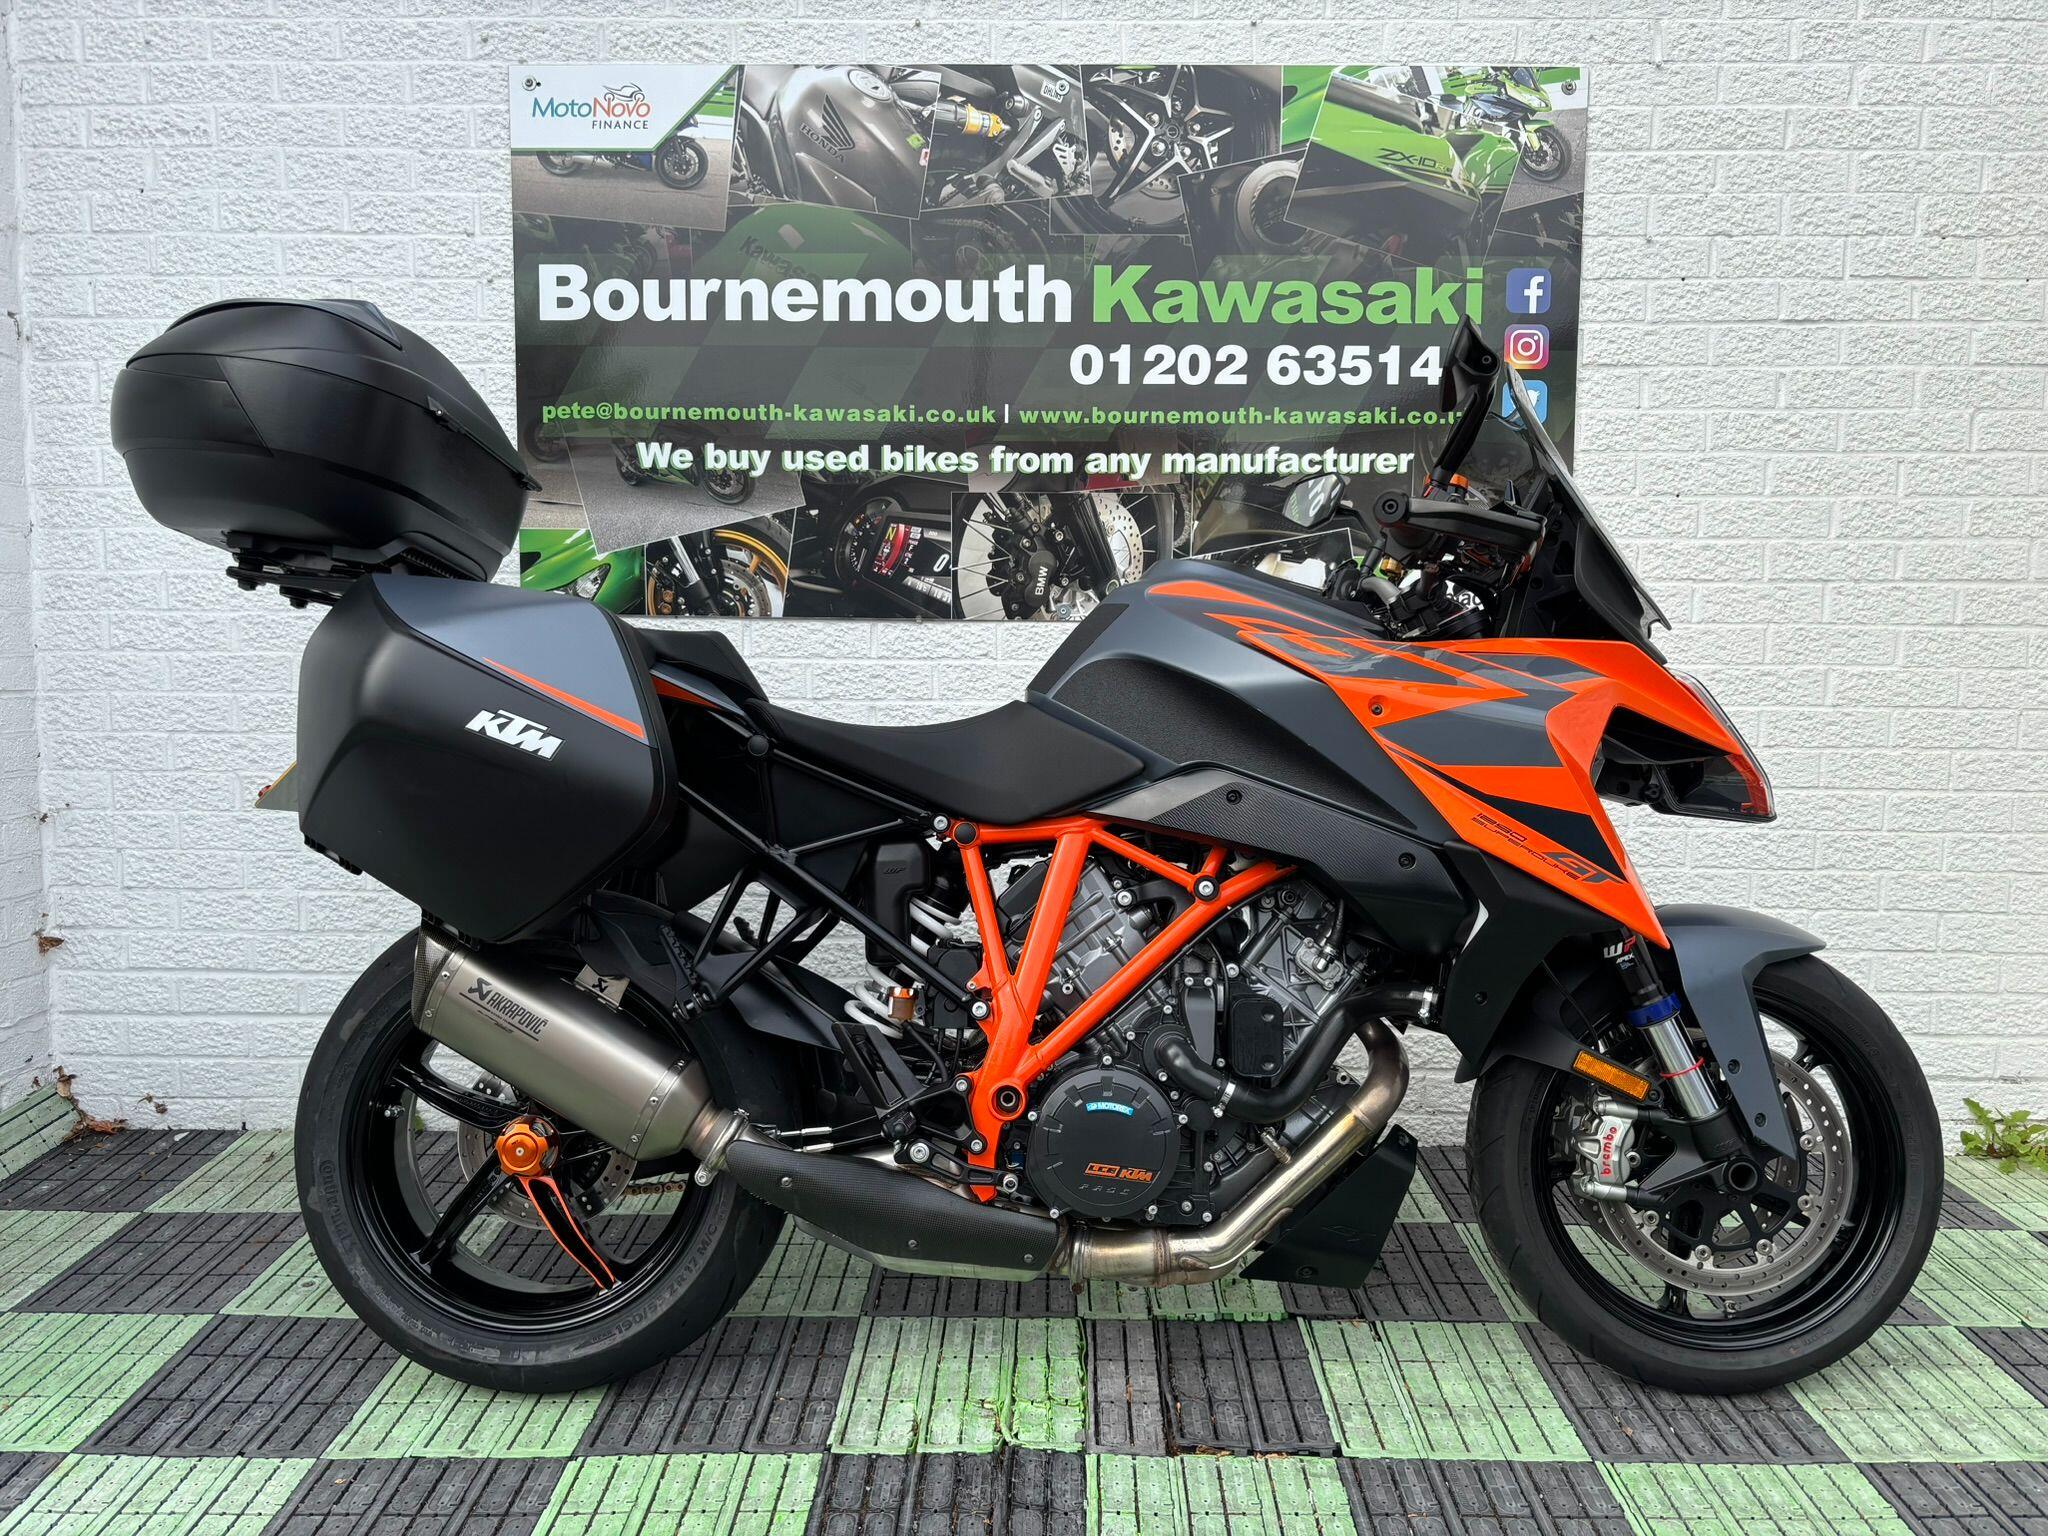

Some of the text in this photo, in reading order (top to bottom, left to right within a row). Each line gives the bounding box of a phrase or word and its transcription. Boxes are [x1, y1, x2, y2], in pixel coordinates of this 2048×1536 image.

[532, 97, 651, 118] MotoNovo
[592, 120, 649, 130] FINANCE
[800, 122, 845, 163] HONDA
[538, 263, 1485, 326] Bournemouth Kawasaki
[1069, 344, 1248, 386] 01202
[542, 402, 996, 424] pete@bournemouth-kawasaki.co.uk
[637, 442, 1415, 480] We buy used bikes from any manufacturer
[1035, 565, 1048, 595] BMW
[465, 709, 564, 760] KTM
[1541, 851, 1624, 884] GT
[1603, 935, 1636, 958] WP
[1600, 1126, 1617, 1175] brembo
[1119, 1167, 1153, 1182] KTM
